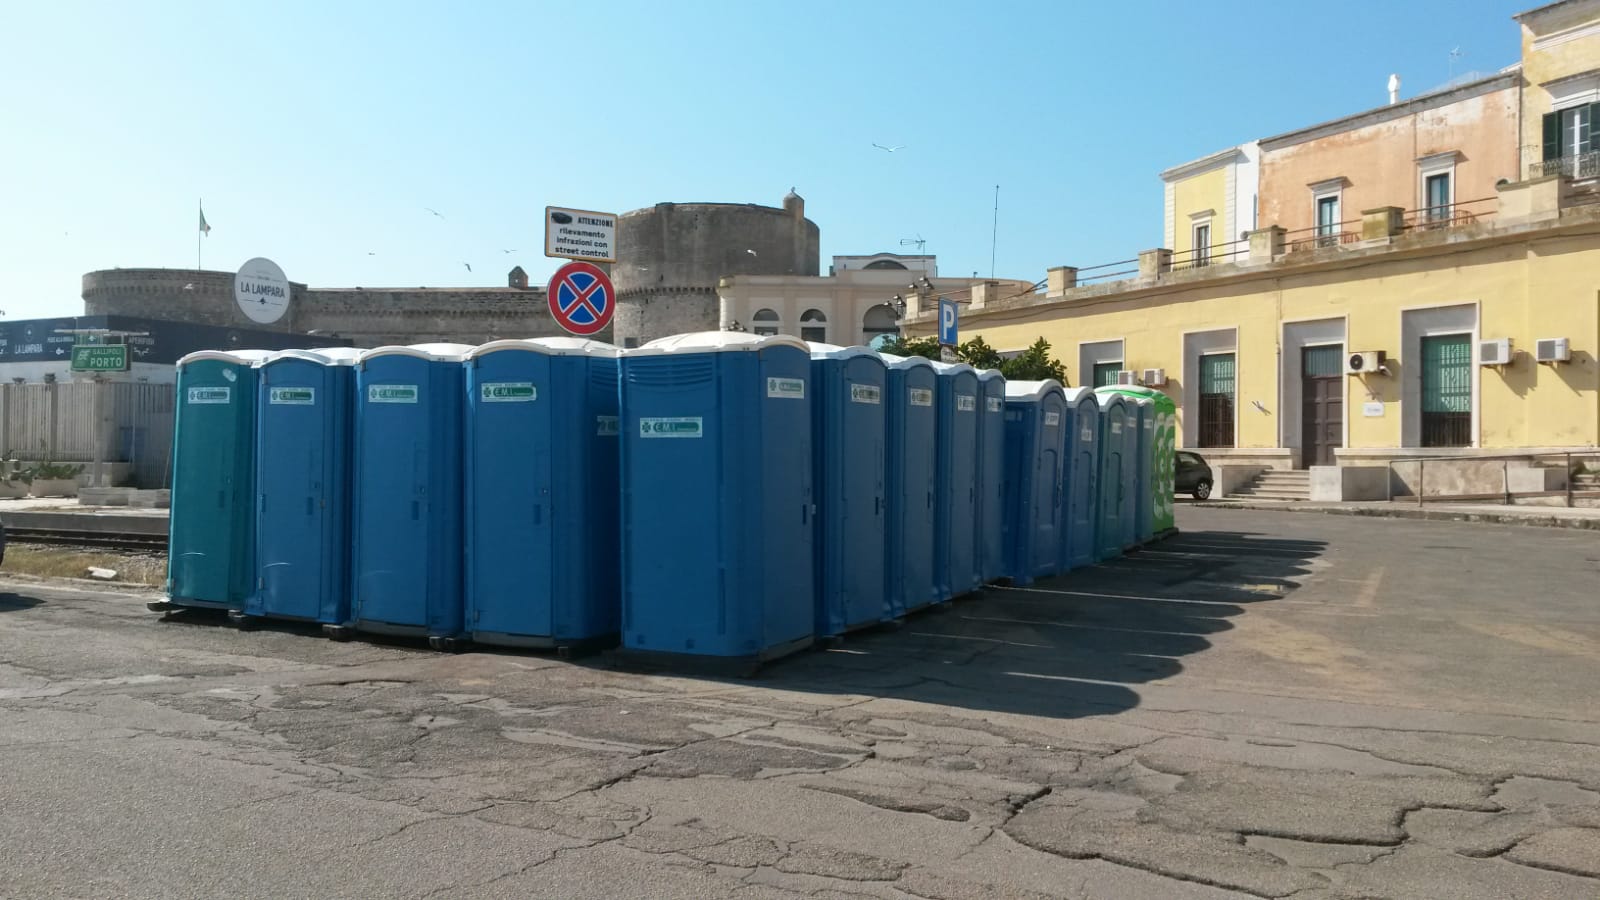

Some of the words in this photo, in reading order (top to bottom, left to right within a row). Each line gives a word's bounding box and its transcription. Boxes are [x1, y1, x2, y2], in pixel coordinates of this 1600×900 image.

[578, 216, 614, 228] ATTENZIONE
[559, 227, 606, 239] rilevamento
[556, 235, 593, 247] infrazioni
[594, 240, 608, 249] con
[555, 246, 579, 255] street
[581, 249, 609, 258] control
[240, 281, 250, 293] LA
[252, 283, 286, 298] LAMPARA
[943, 303, 955, 340] P
[90, 357, 122, 367] PORTO
